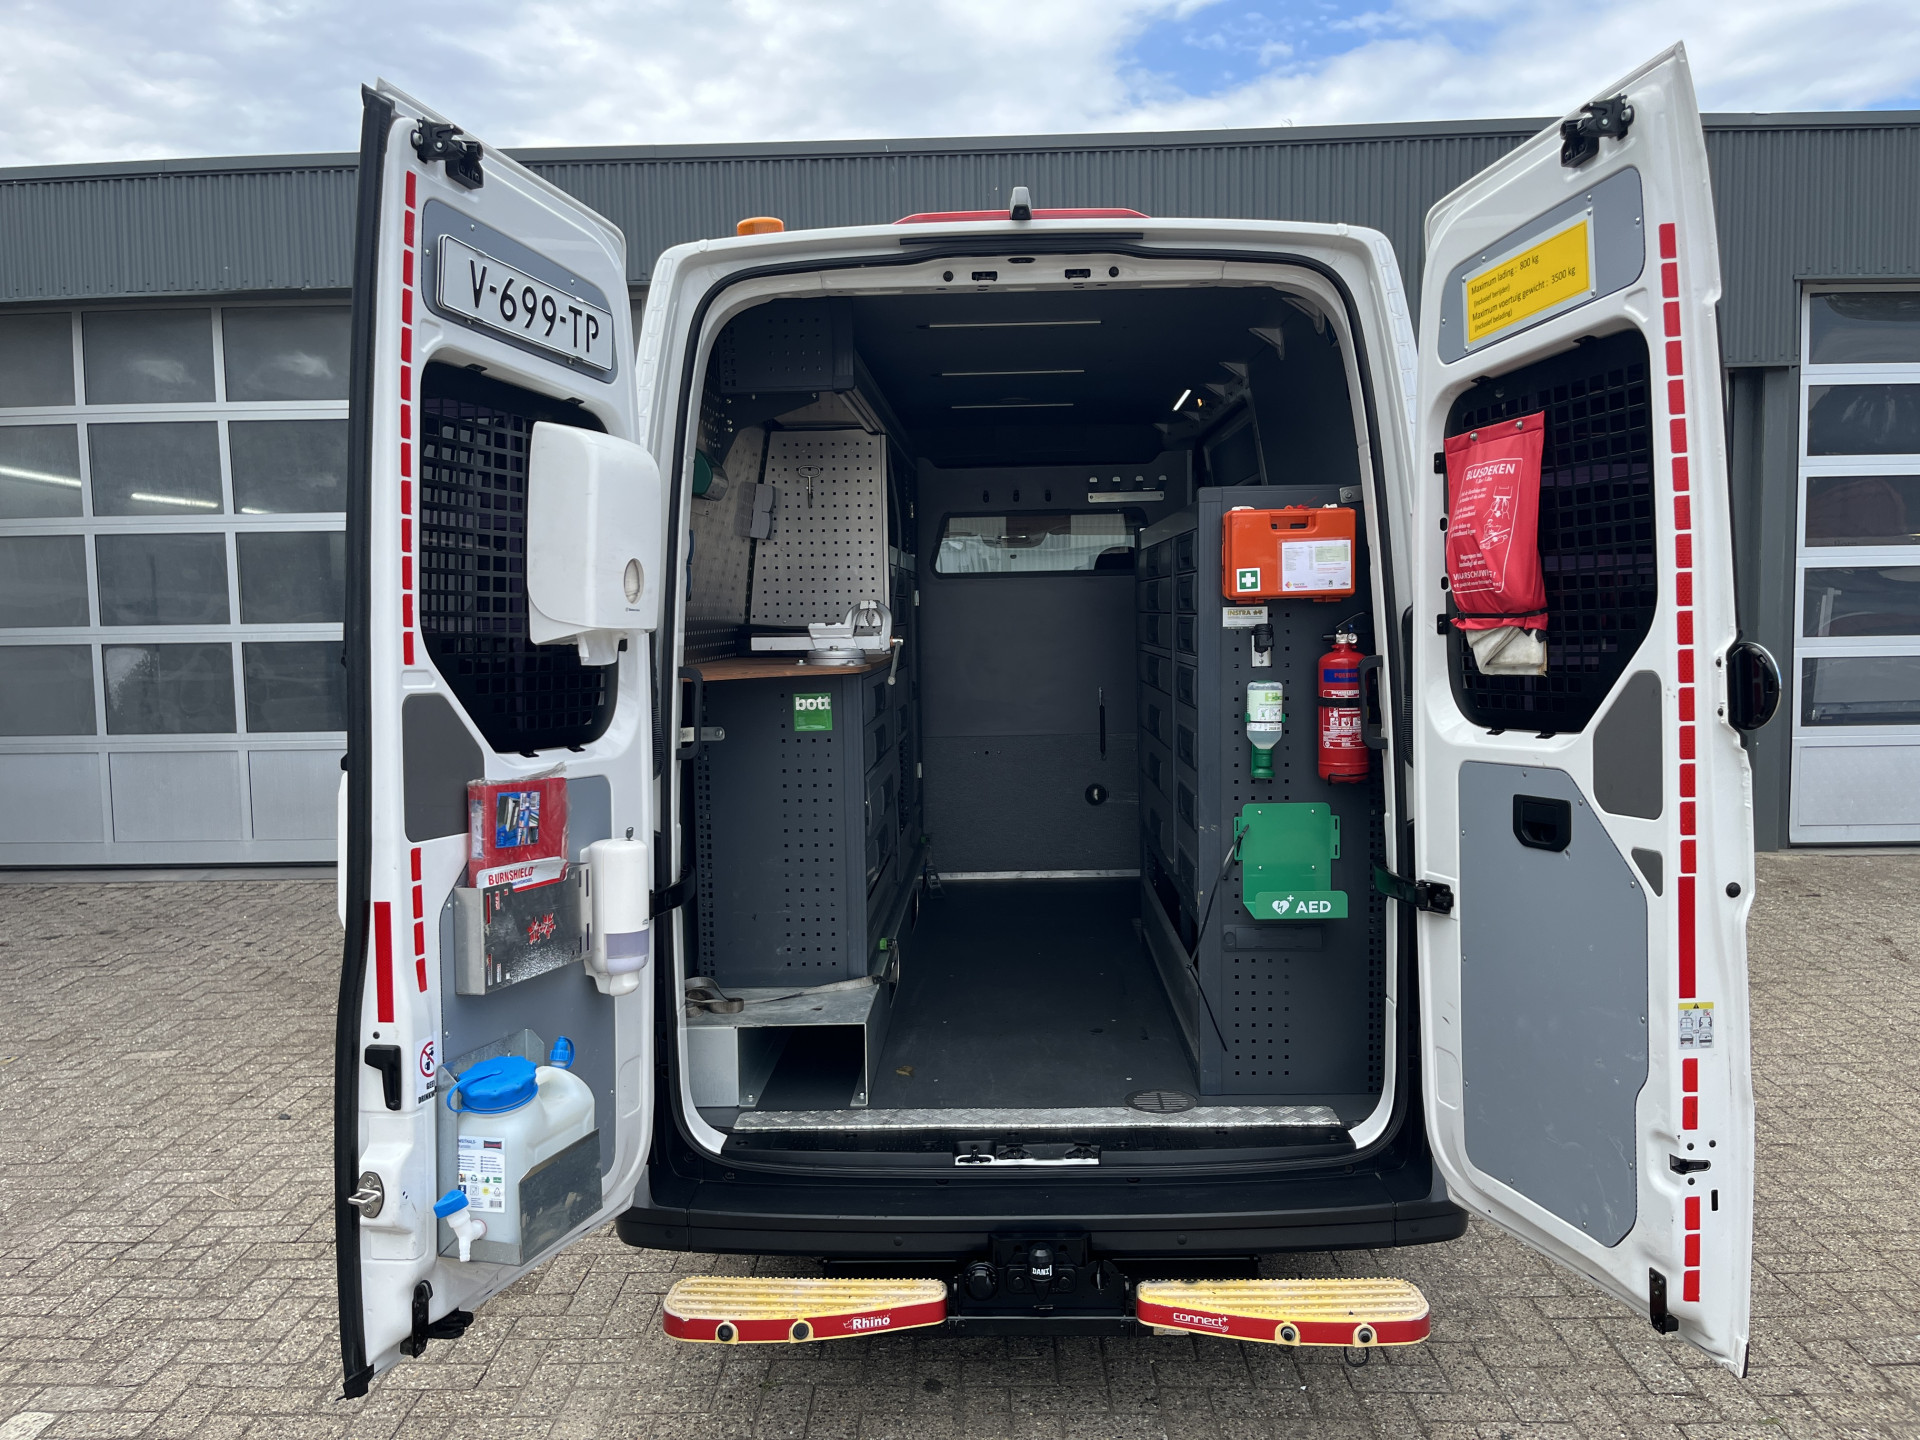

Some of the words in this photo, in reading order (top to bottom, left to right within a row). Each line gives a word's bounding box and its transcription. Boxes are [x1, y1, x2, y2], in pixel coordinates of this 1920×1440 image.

[1471, 276, 1497, 295] Maximum
[1497, 266, 1514, 282] lading
[1519, 259, 1531, 270] 800
[1531, 255, 1539, 265] kg
[1472, 303, 1498, 321] Maximum
[1498, 293, 1522, 309] voertuig
[1522, 280, 1545, 299] gewicht
[1551, 269, 1567, 284] 3500
[1567, 267, 1576, 277] kg
[469, 259, 600, 353] V-699-TP
[1466, 464, 1516, 481] BLUSDEKEN
[795, 695, 831, 711] bott
[488, 866, 535, 886] BURNSHIELD
[1295, 900, 1332, 914] AED
[426, 1079, 436, 1090] GEE
[852, 1316, 891, 1330] Rhino
